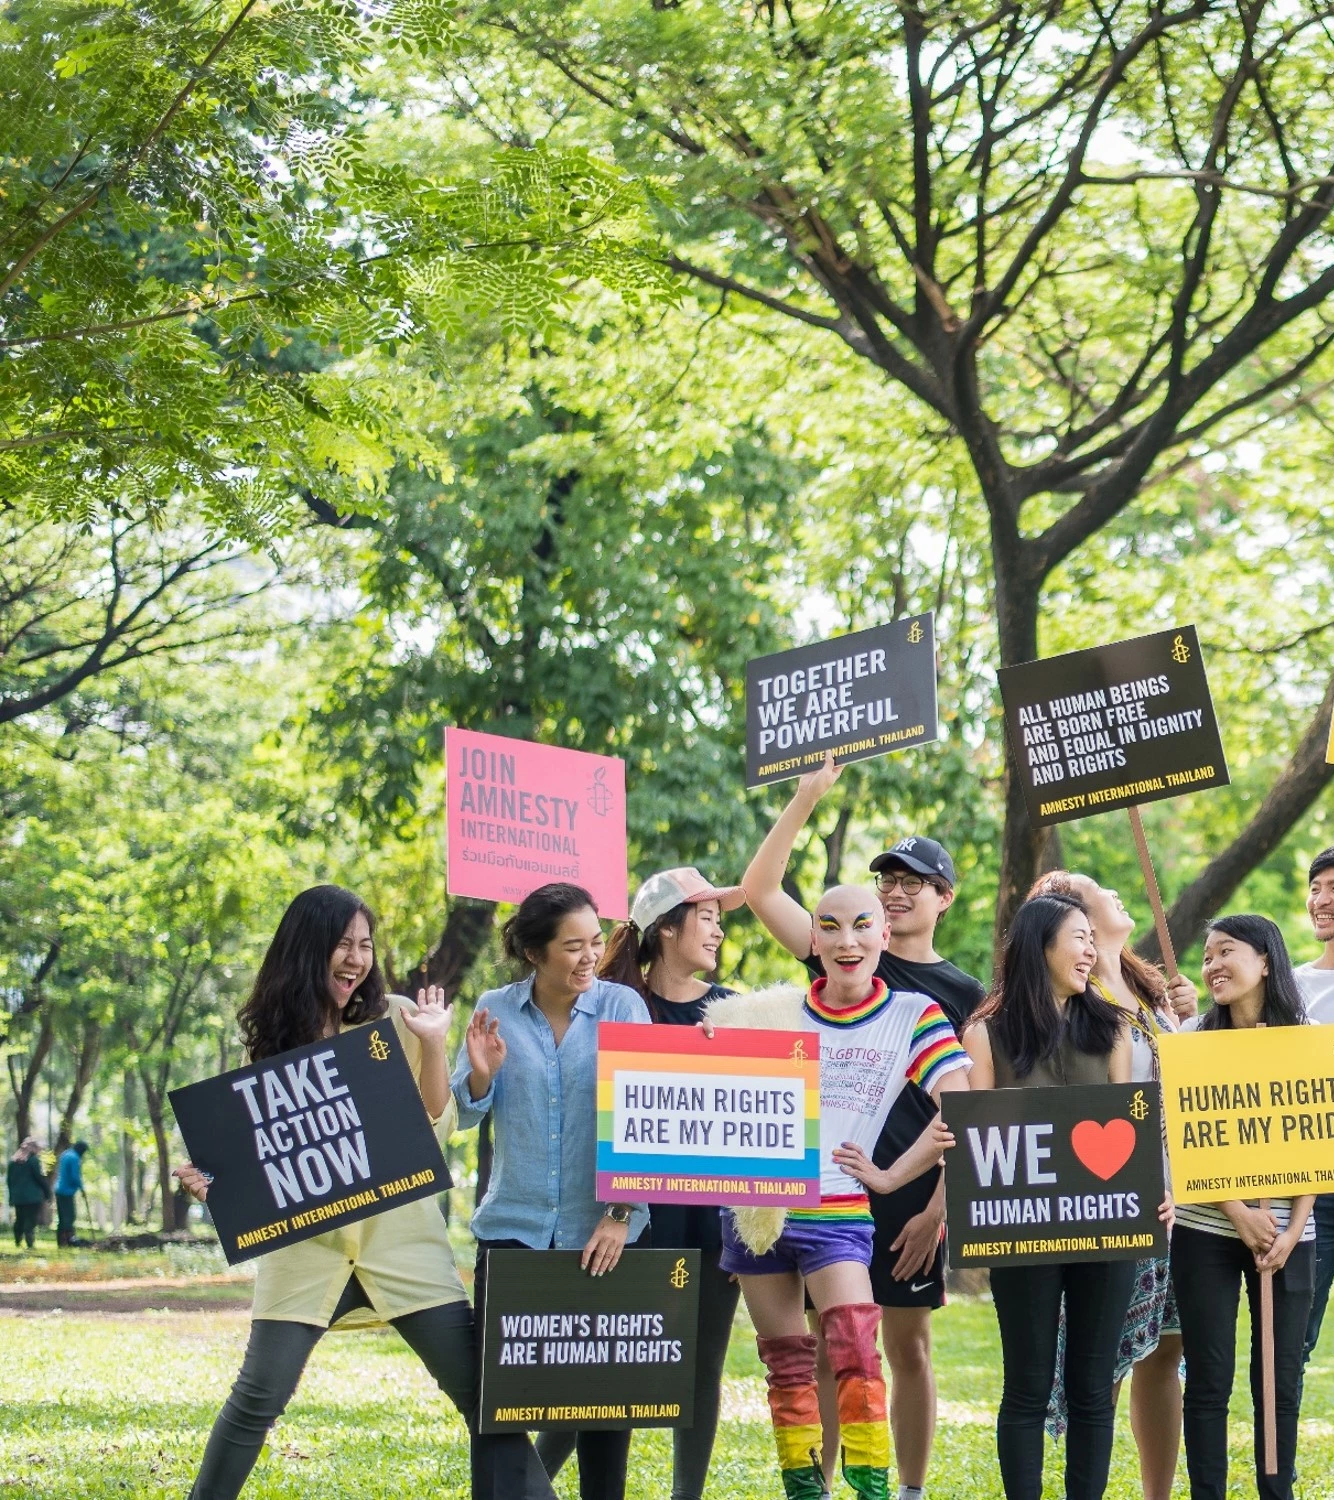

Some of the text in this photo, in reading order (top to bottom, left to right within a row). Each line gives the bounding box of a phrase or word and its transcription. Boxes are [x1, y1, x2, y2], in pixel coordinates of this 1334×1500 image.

[757, 648, 886, 702] TOGETHER
[757, 681, 853, 728] WE ARE
[1018, 674, 1169, 726] ALL HUMAN BEINGS
[759, 697, 898, 754] POWERFUL
[1023, 700, 1148, 746] ARE BORN FREE
[1027, 708, 1201, 766] AND EQUAL IN DIGNITY
[459, 747, 516, 786] JOIN
[758, 724, 924, 776] AMNESTY INTENATIONAL THAILAND
[1032, 748, 1126, 786] AND RIGHTS
[459, 781, 578, 830] AMNESTY
[1040, 765, 1215, 816] AMNESTY INTERNATIONAL THAILAND
[460, 818, 580, 856] INTERNATIONAL
[231, 1049, 349, 1124] TAKE
[625, 1084, 704, 1111] HUMAN
[714, 1088, 794, 1114] RIGHTS
[1178, 1082, 1261, 1112] HUMAN
[254, 1096, 361, 1160] ACTION
[624, 1117, 794, 1148] ARE MY PRIDE
[1183, 1119, 1229, 1149] ARE
[1237, 1116, 1272, 1144] MY
[263, 1130, 370, 1208] NOW
[966, 1123, 1057, 1187] WE
[611, 1176, 806, 1195] AMNESTY INTERNATIONAL THAILAND
[1186, 1176, 1231, 1191] AMNESTY
[1235, 1171, 1312, 1187] INTERNATIONAL
[237, 1168, 434, 1249] AMNESTY INTERNATIONAL THAILAND
[971, 1192, 1140, 1226] HUMAN RIGHTS
[962, 1233, 1153, 1256] AMNESTY INTERNATIONAL THAILAND
[501, 1313, 663, 1337] WOMEN'S RIGHTS
[499, 1340, 681, 1365] ARE HUMAN RIGHTS
[495, 1403, 680, 1421] AMNESTY INTERNATIONAL THAILAND
